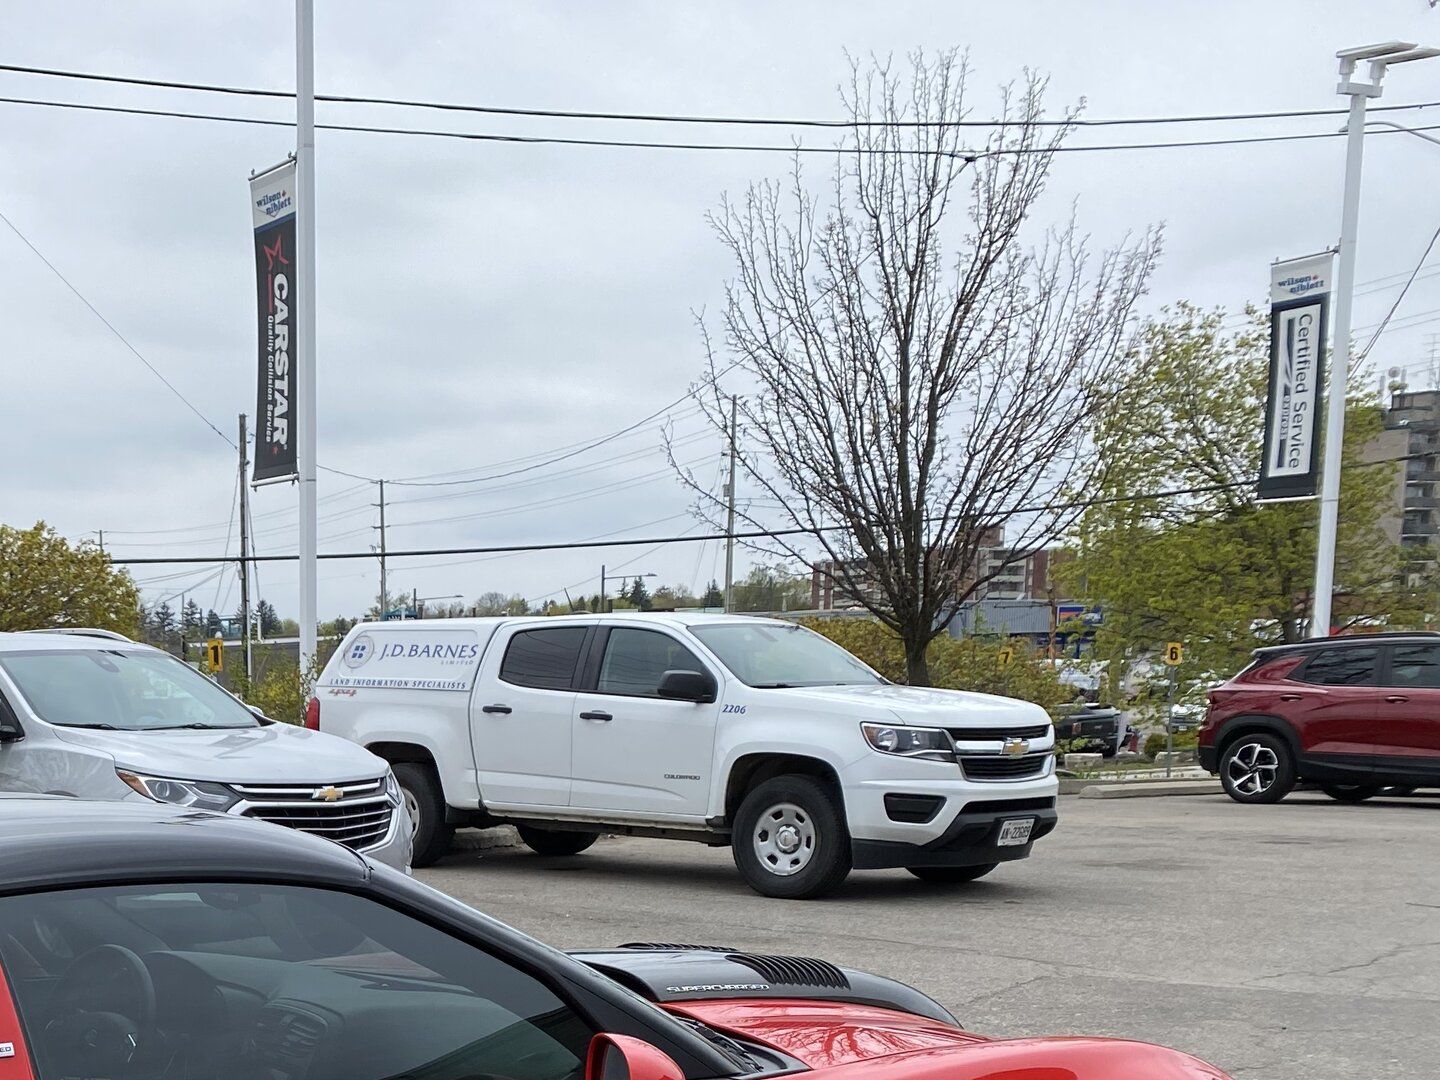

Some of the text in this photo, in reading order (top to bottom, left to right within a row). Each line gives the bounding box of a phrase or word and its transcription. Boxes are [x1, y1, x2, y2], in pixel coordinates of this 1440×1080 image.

[256, 191, 281, 207] wilson
[1277, 274, 1311, 287] wilson
[266, 315, 274, 352] Quality
[273, 273, 289, 446] CARSTAR
[1288, 313, 1314, 469] Certified Service
[266, 404, 274, 442] Service
[211, 645, 219, 665] 1
[1169, 647, 1178, 660] 6
[353, 679, 408, 687] INFORMATION
[412, 680, 466, 689] SPECIALISTS
[722, 704, 746, 714] 2206
[666, 984, 770, 993] SUPERCHARGED
